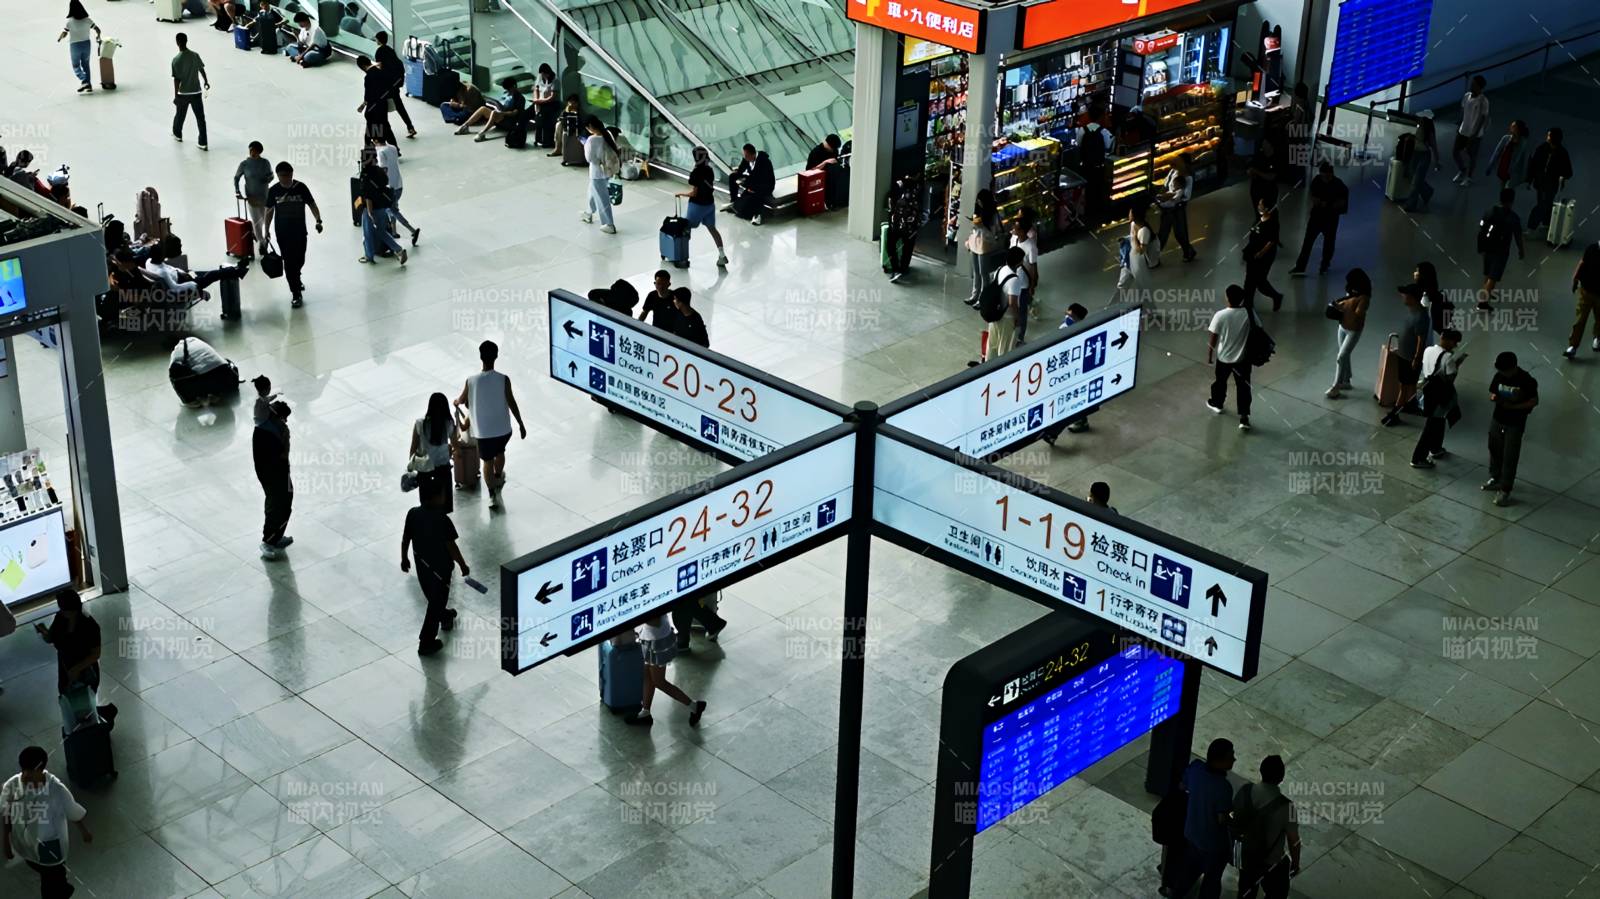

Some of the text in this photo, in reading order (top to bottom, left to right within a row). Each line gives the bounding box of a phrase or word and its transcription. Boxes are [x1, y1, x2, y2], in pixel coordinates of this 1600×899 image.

[619, 335, 660, 367] 检票口
[661, 354, 758, 423] 20-23
[980, 362, 1043, 416] 1-19
[612, 478, 775, 565] 检票口 24-32
[782, 511, 812, 534] 卫生间
[995, 495, 1148, 572] 1-19 检票口
[743, 536, 756, 562] 2
[948, 525, 981, 549] 卫生间
[611, 557, 656, 584] Check in
[1026, 555, 1060, 581] 饮用水
[1097, 560, 1146, 590] Check in
[1096, 588, 1105, 612] 1
[1044, 642, 1090, 682] 24-32
